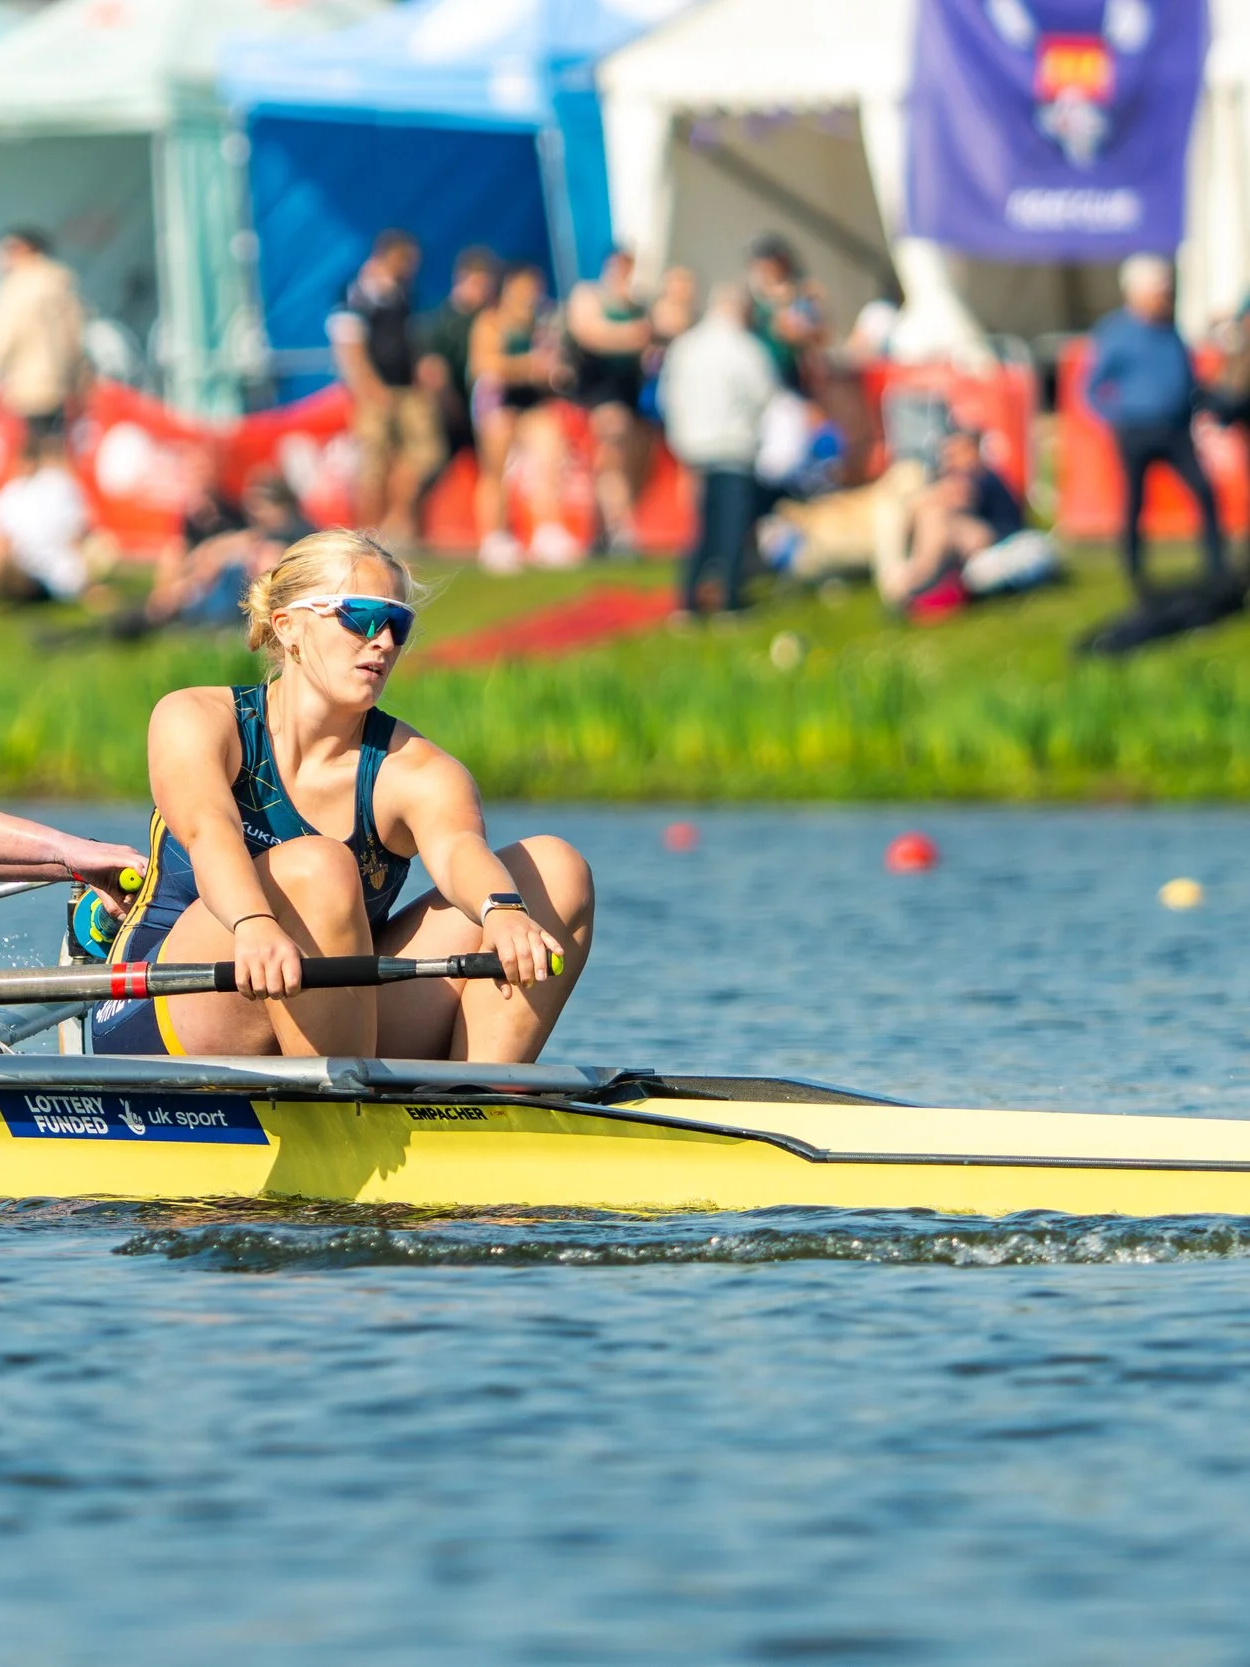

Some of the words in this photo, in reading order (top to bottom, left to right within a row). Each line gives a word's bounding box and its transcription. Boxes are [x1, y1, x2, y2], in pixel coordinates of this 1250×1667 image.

[241, 821, 284, 846] KUKR
[24, 1095, 105, 1114] LOTTERY
[405, 1107, 489, 1121] EMPACHER
[33, 1115, 109, 1134] FUNDED
[148, 1107, 171, 1125] uk
[174, 1109, 228, 1129] sport
